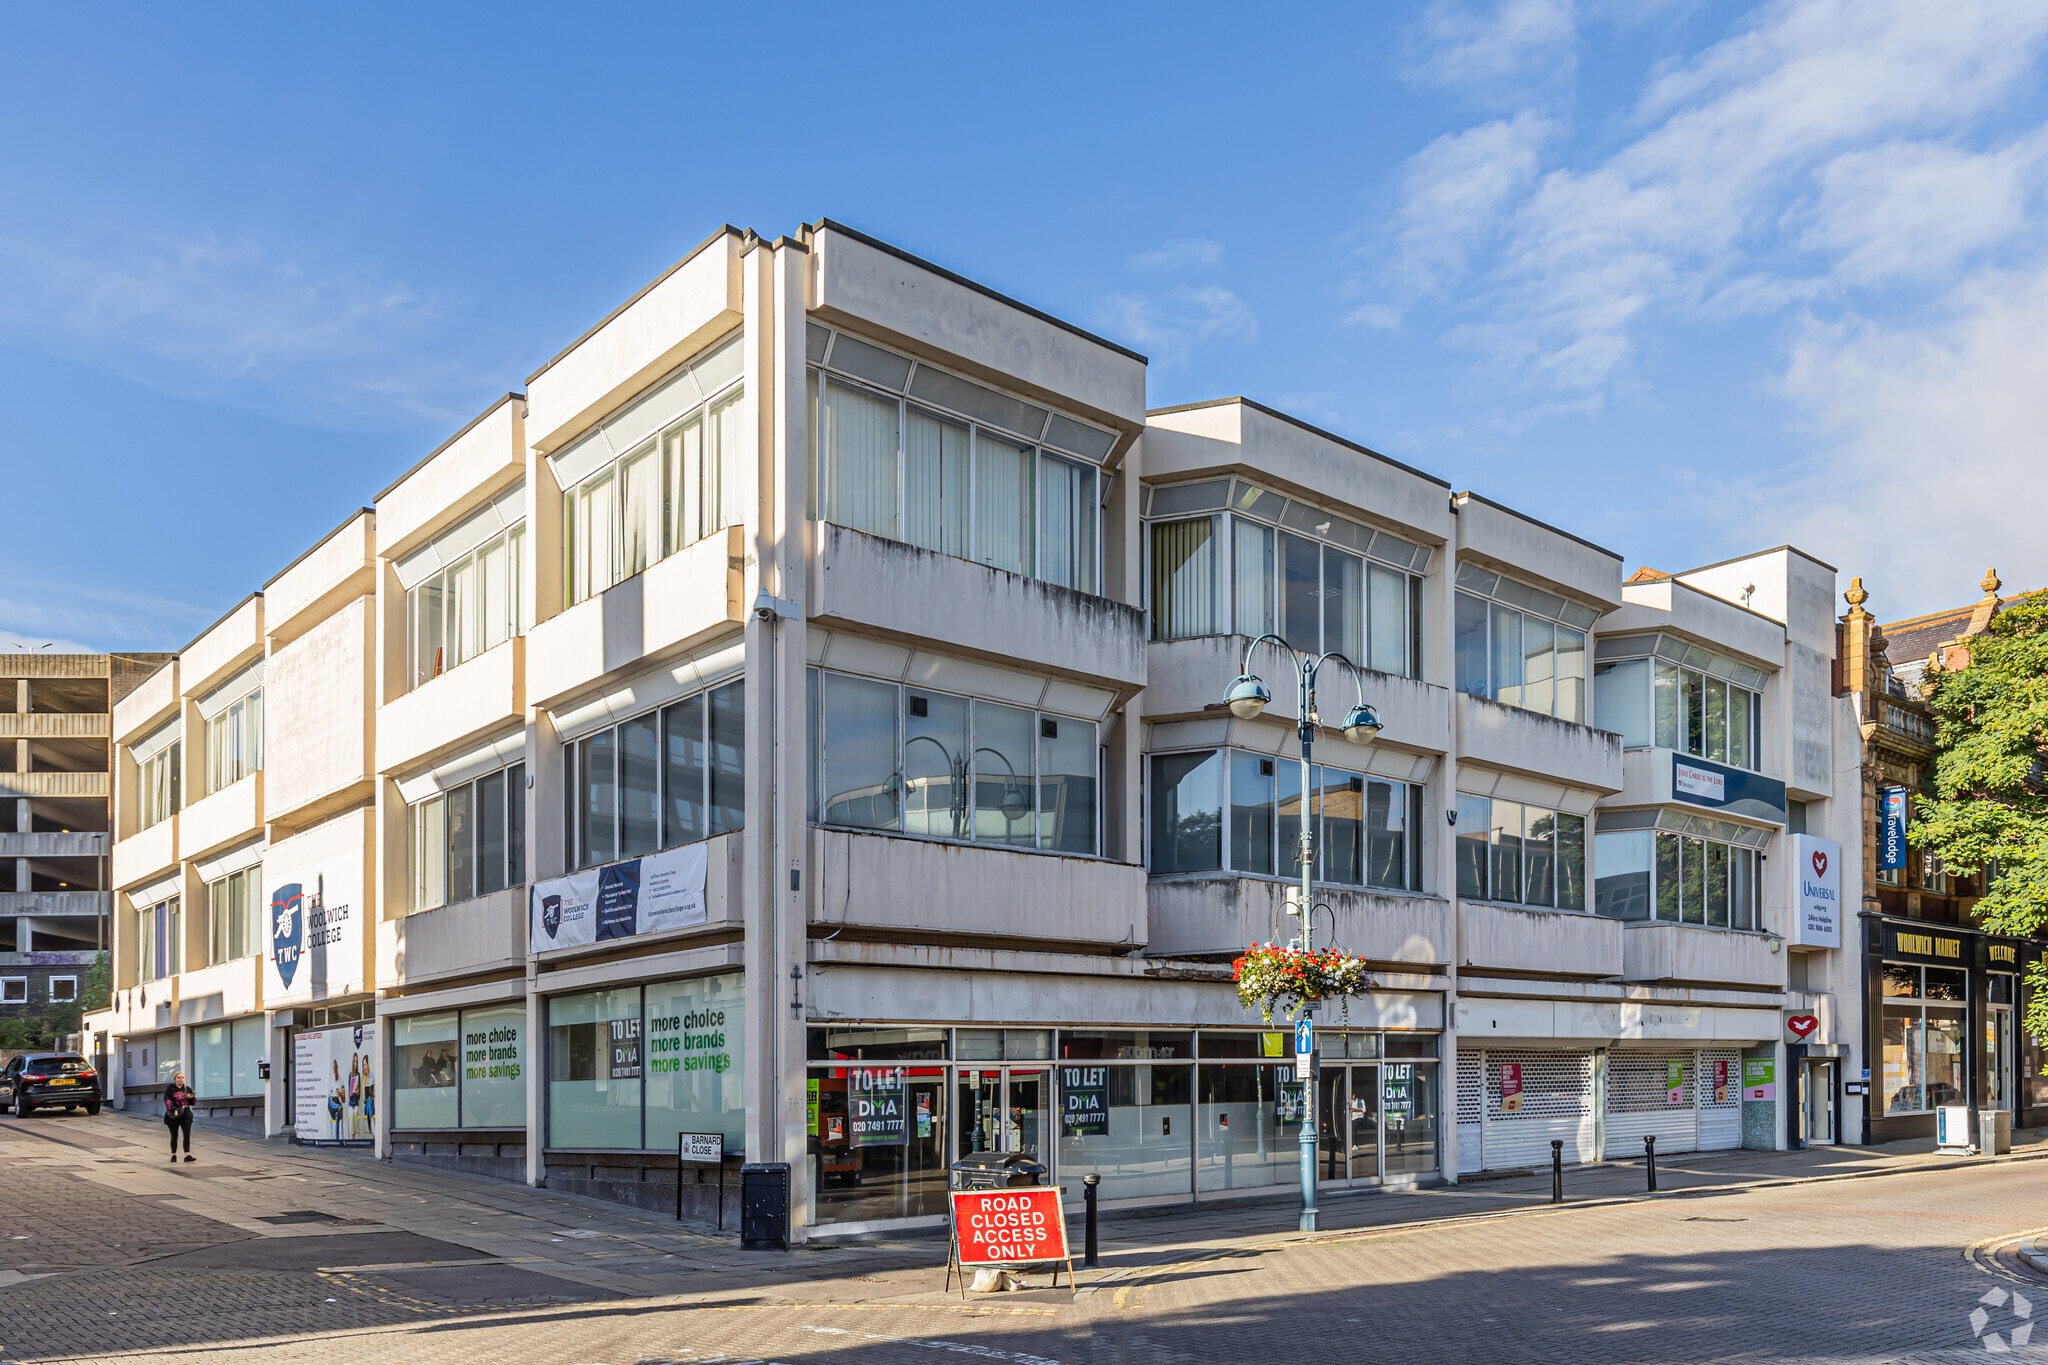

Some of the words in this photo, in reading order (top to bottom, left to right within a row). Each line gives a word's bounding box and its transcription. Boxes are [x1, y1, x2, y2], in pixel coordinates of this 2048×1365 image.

[1886, 811, 1900, 864] Travelodge
[1803, 880, 1836, 901] UNIVERSAL
[307, 893, 321, 910] THE
[563, 903, 590, 914] WOOLWICH
[307, 904, 349, 929] WOOLWICH
[563, 912, 585, 922] COLLEGE
[307, 926, 342, 949] COLLEGE
[1897, 932, 1933, 956] WOOLWICH
[1935, 937, 1961, 959] MARKET
[278, 945, 298, 964] TWC
[1988, 944, 2016, 964] WELCOME
[611, 1020, 624, 1040] TO
[651, 1015, 680, 1033] more
[683, 1008, 725, 1030] choice
[466, 1032, 487, 1046] more
[488, 1026, 517, 1044] choice
[651, 1036, 680, 1053] more
[683, 1029, 725, 1050] brands
[466, 1049, 487, 1063] more
[488, 1043, 518, 1061] brands
[651, 1056, 680, 1073] more
[683, 1051, 731, 1074] savings
[466, 1066, 487, 1080] more
[488, 1061, 521, 1081] savings
[853, 1069, 873, 1091] TO
[876, 1067, 904, 1090] LET
[1064, 1067, 1081, 1087] TO
[1083, 1066, 1106, 1086] LET
[1277, 1066, 1290, 1083] TO
[1383, 1065, 1395, 1083] TO
[1396, 1064, 1412, 1080] LET
[1069, 1094, 1099, 1110] DMA
[1386, 1086, 1407, 1099] DMA
[859, 1099, 897, 1117] DMA
[853, 1121, 866, 1132] 020
[867, 1120, 885, 1132] 7491
[886, 1119, 904, 1131] 7777
[1064, 1114, 1076, 1124] 020
[1089, 1112, 1106, 1123] 7777
[691, 1135, 721, 1145] BARNARD
[691, 1145, 712, 1155] CLOSE
[980, 1196, 1032, 1212] ROAD
[970, 1211, 1045, 1228] CLOSED
[972, 1227, 1047, 1244] ACCESS
[987, 1243, 1036, 1259] ONLY
